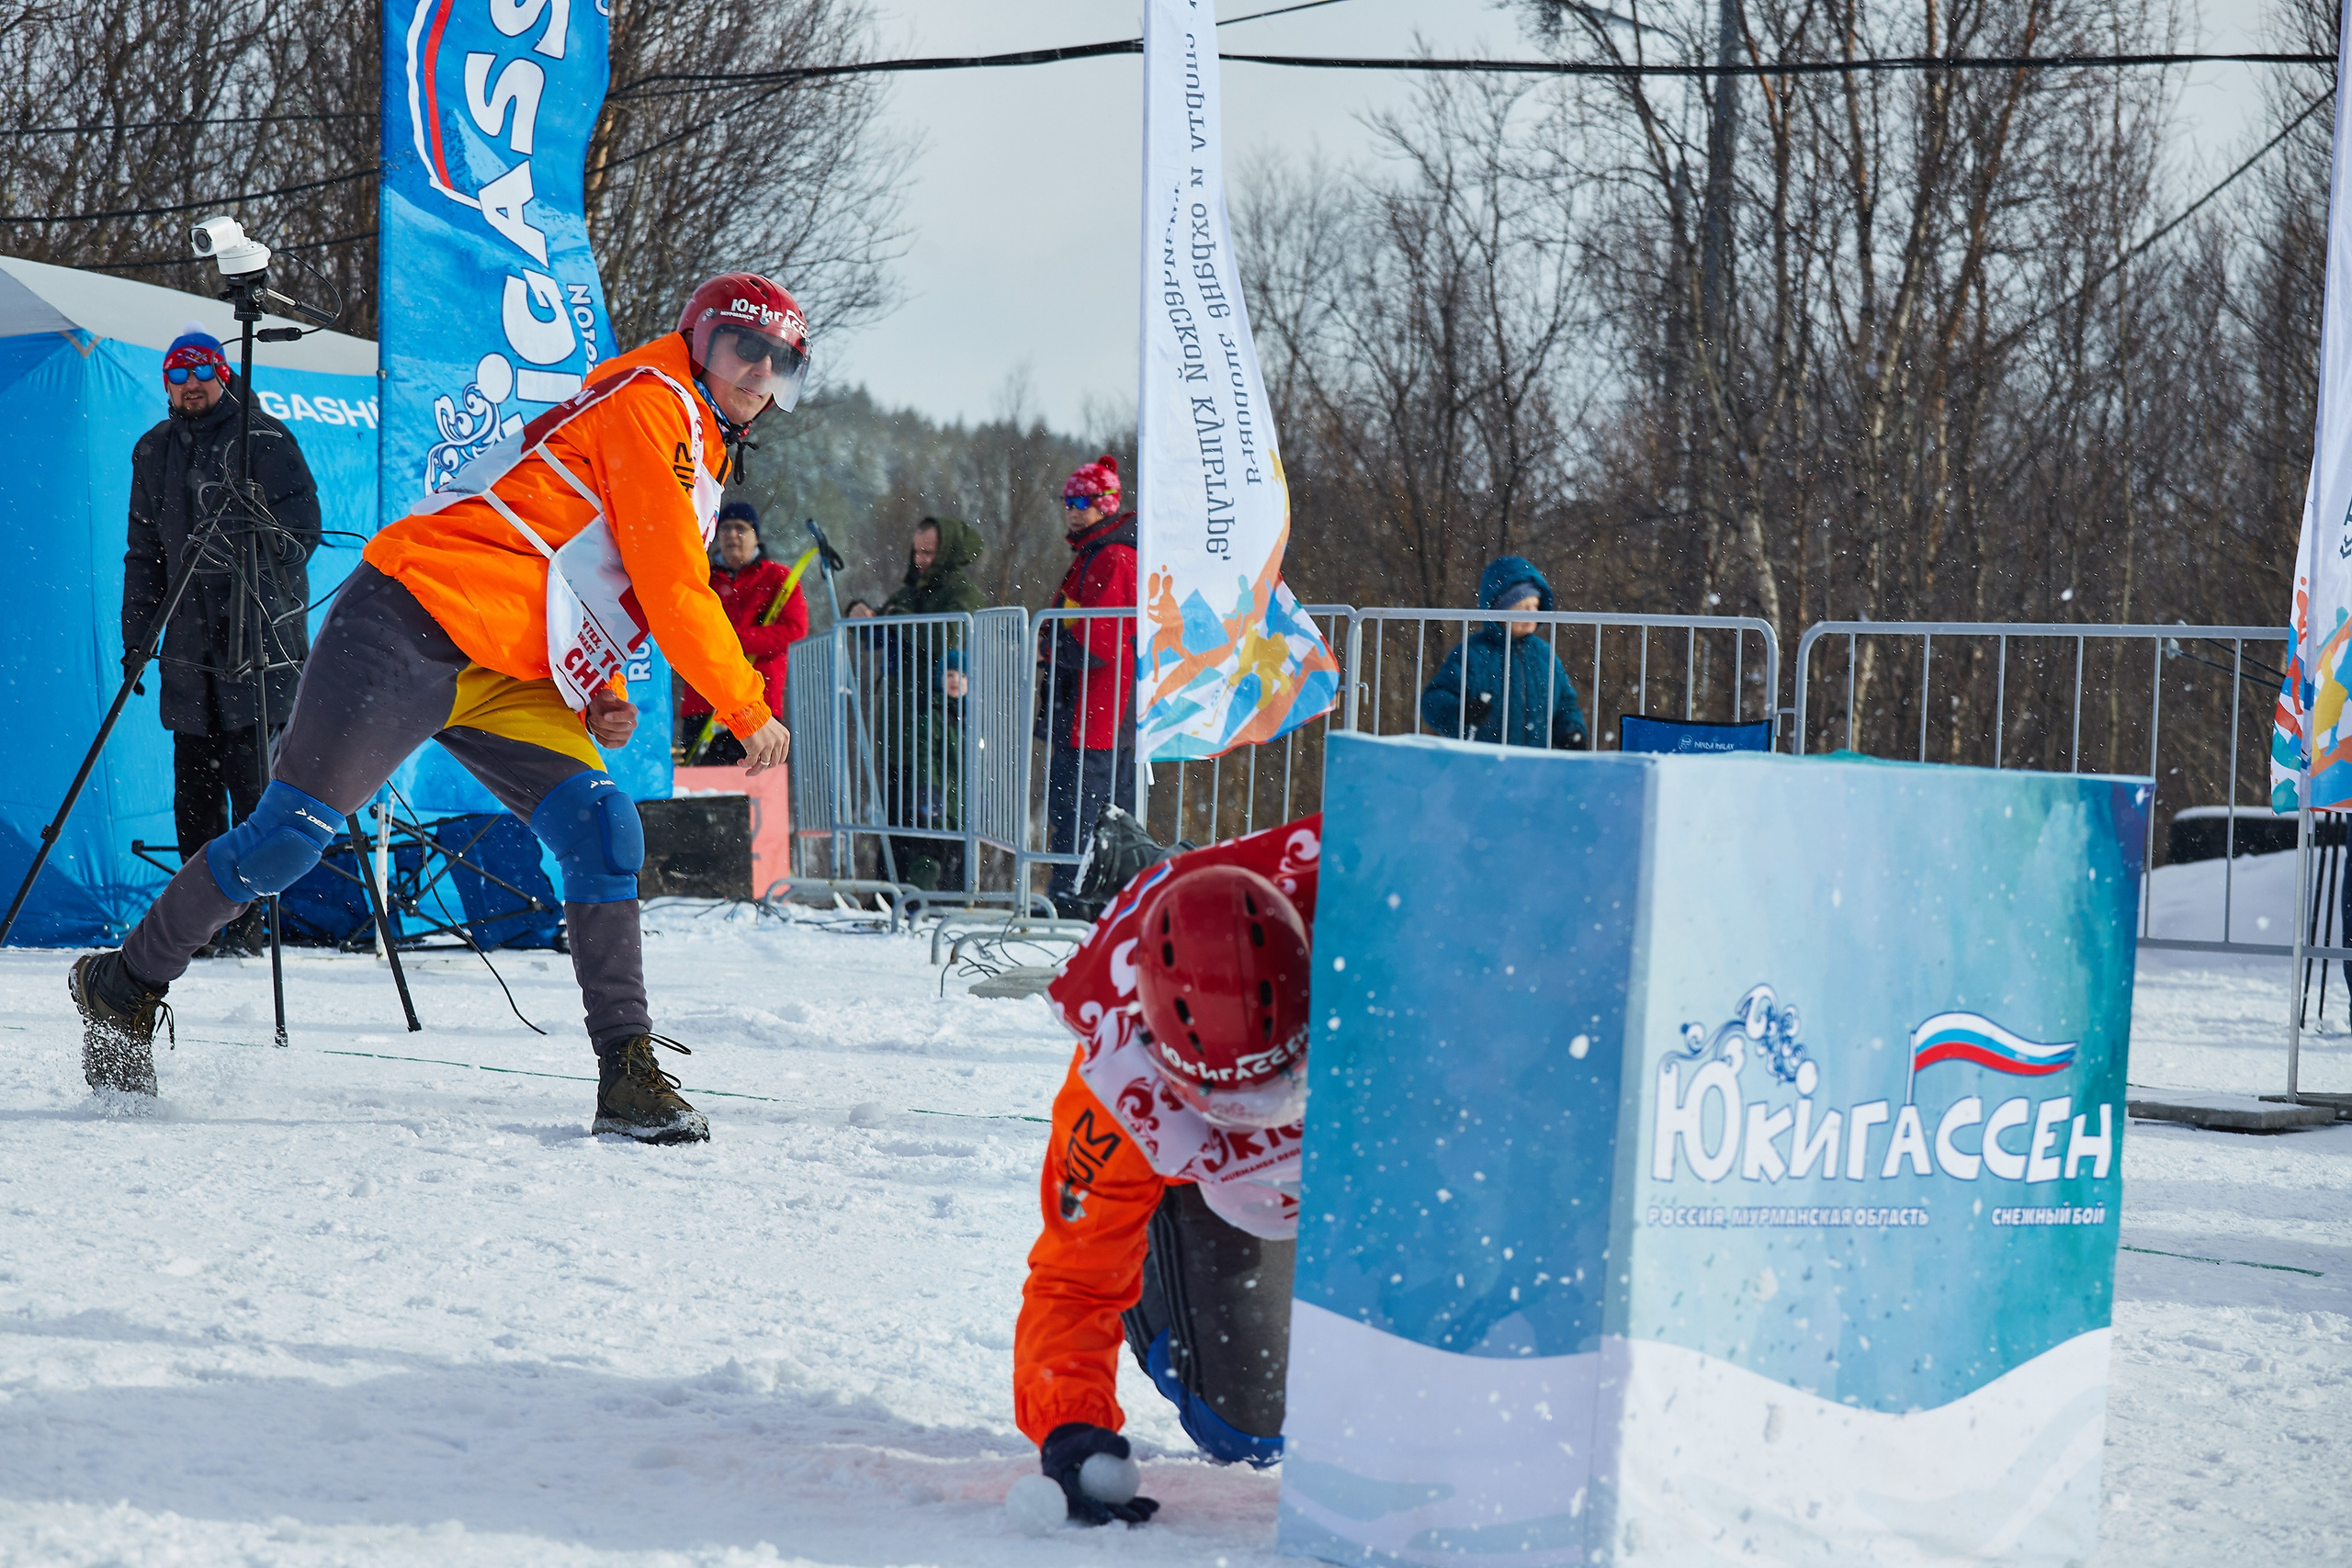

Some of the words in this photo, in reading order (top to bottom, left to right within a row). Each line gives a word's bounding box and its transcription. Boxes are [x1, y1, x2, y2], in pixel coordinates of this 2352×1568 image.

[1731, 1205, 1852, 1228] МУРМАНСКАЯ
[1853, 1206, 1929, 1227] ОБЛАСТЬ
[1991, 1201, 2071, 1226] СНЕЖНЫЙ
[2072, 1201, 2106, 1224] БОЙ
